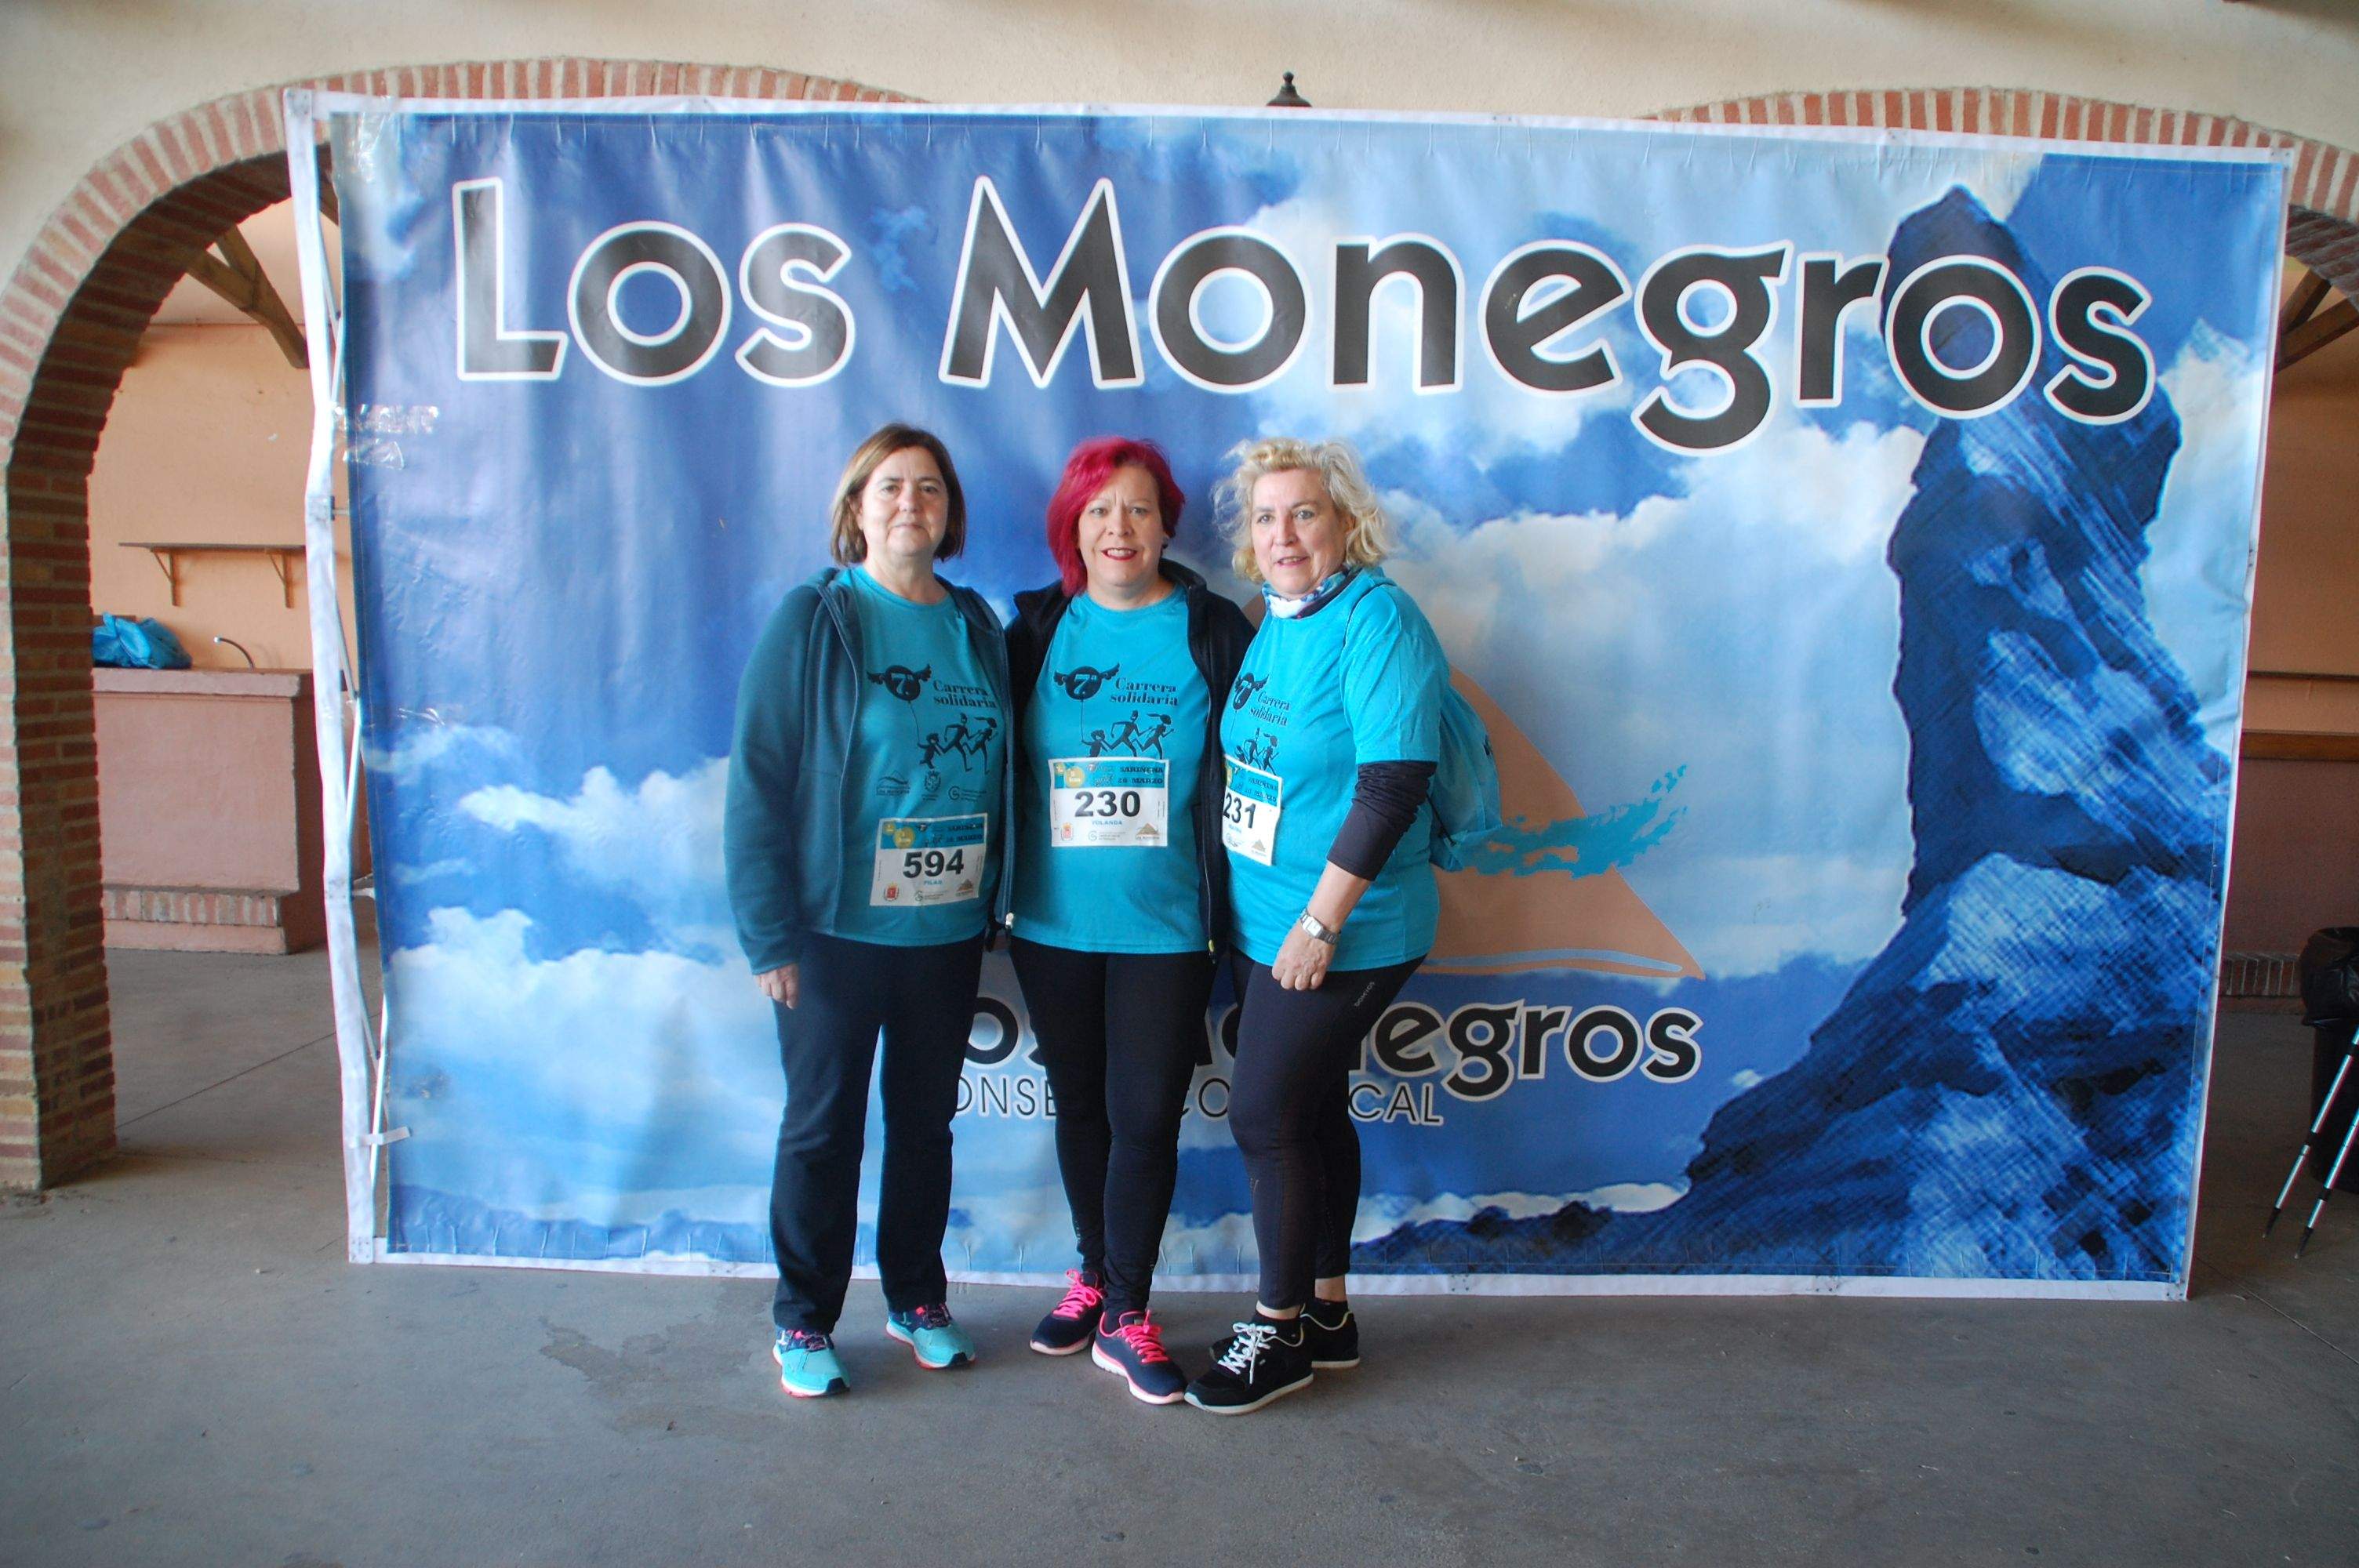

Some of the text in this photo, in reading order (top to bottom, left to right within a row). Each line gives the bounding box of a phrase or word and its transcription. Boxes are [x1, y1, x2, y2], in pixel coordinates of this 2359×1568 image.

[453, 174, 2157, 458] Los Monegros
[932, 680, 988, 696] Carrera
[1115, 677, 1176, 692] Carrera
[932, 694, 998, 708] solidaria
[1110, 691, 1179, 706] solidaria
[1257, 691, 1290, 711] Carrera
[1249, 706, 1288, 727] solidaria
[1074, 790, 1141, 818] 230
[1223, 793, 1256, 829] 231
[903, 848, 965, 879] 594
